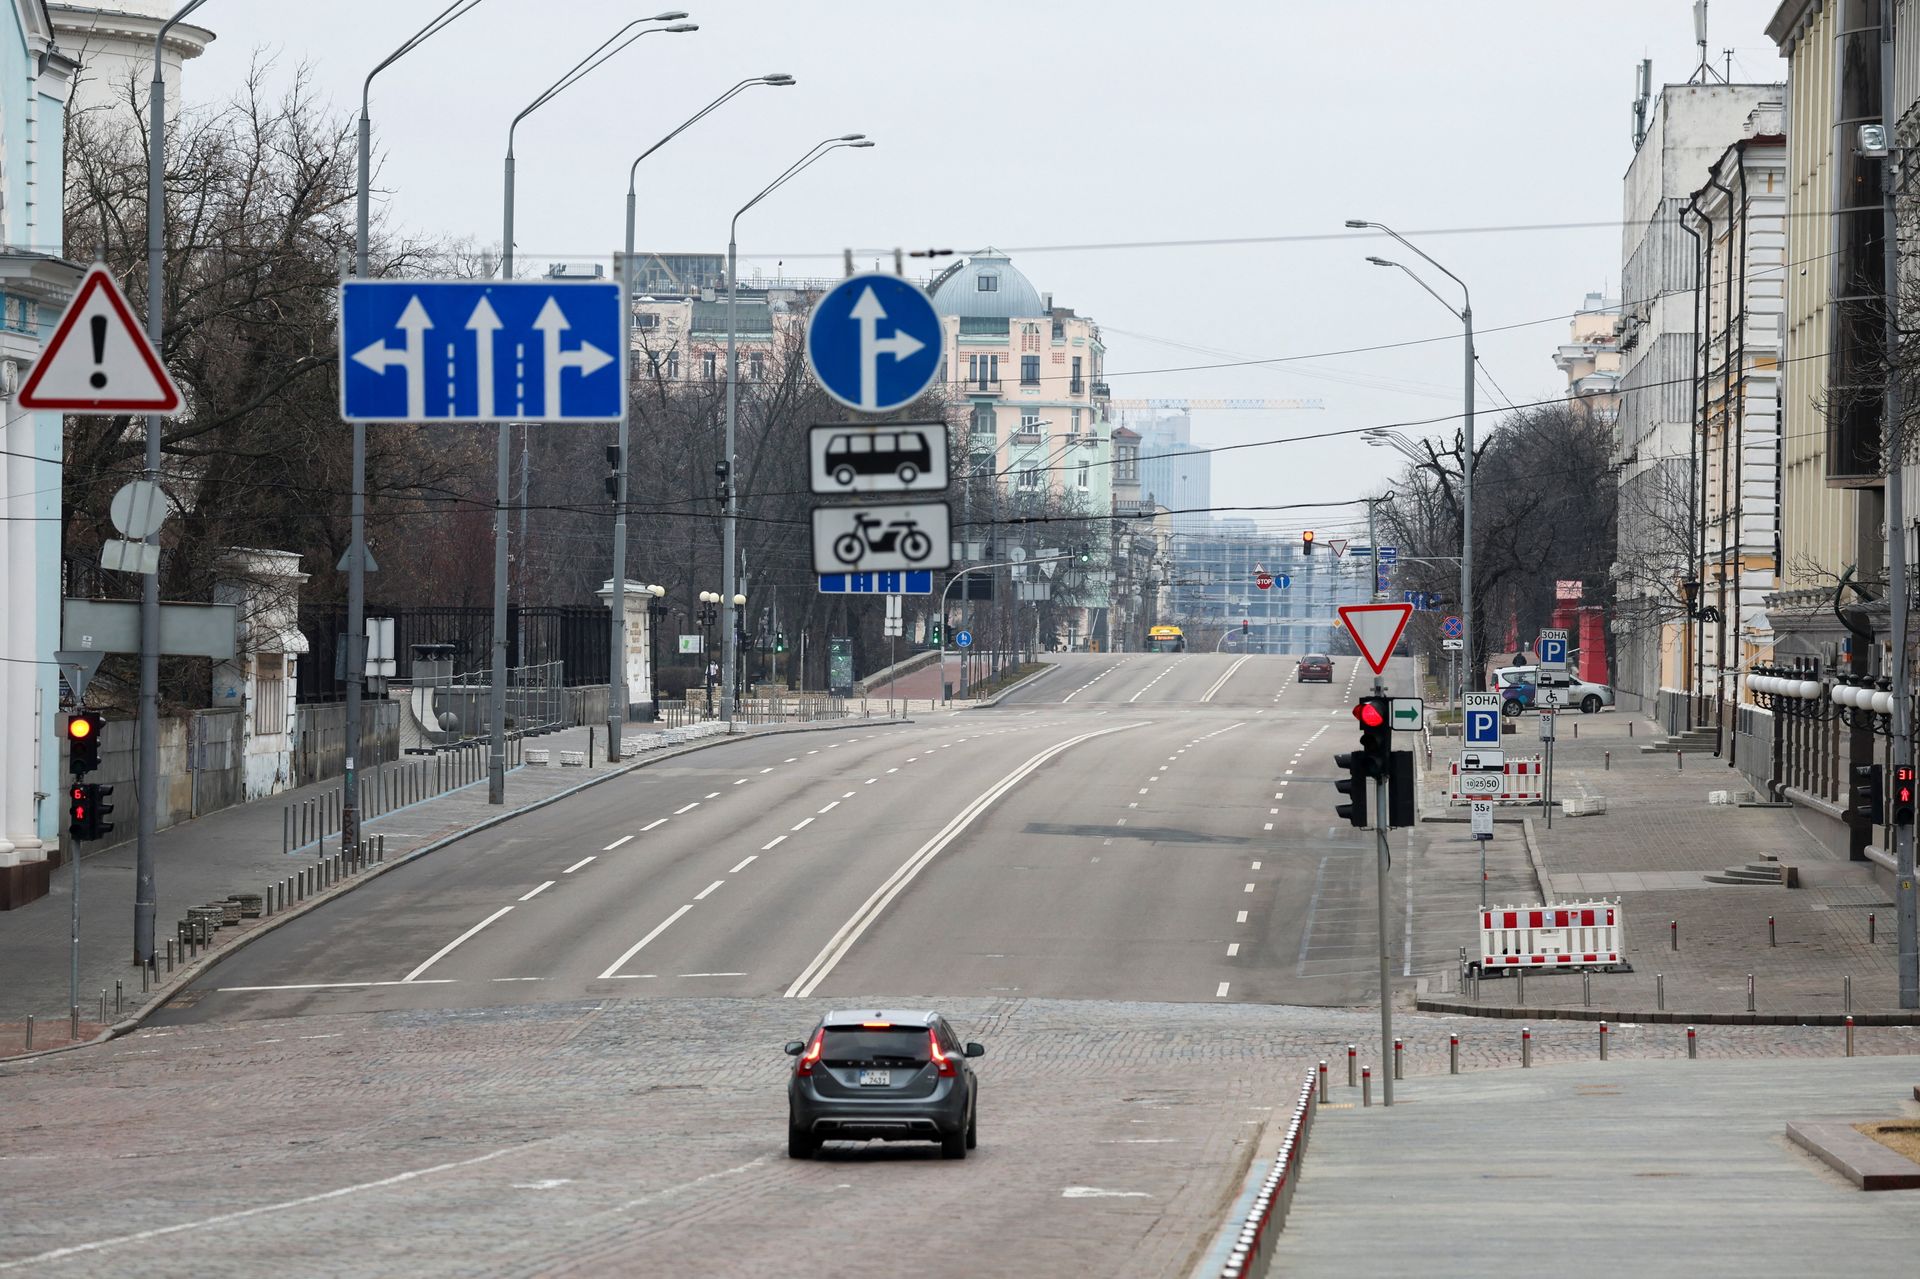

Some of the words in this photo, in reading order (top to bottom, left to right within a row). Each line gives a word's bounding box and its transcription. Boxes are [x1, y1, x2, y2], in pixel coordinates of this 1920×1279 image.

[1541, 630, 1567, 640] ЗОНА
[1547, 642, 1561, 661] P
[1466, 695, 1499, 706] ЗОНА
[1475, 713, 1493, 739] P
[1899, 769, 1913, 780] 31
[1475, 780, 1484, 788] 25
[1486, 779, 1497, 788] 50
